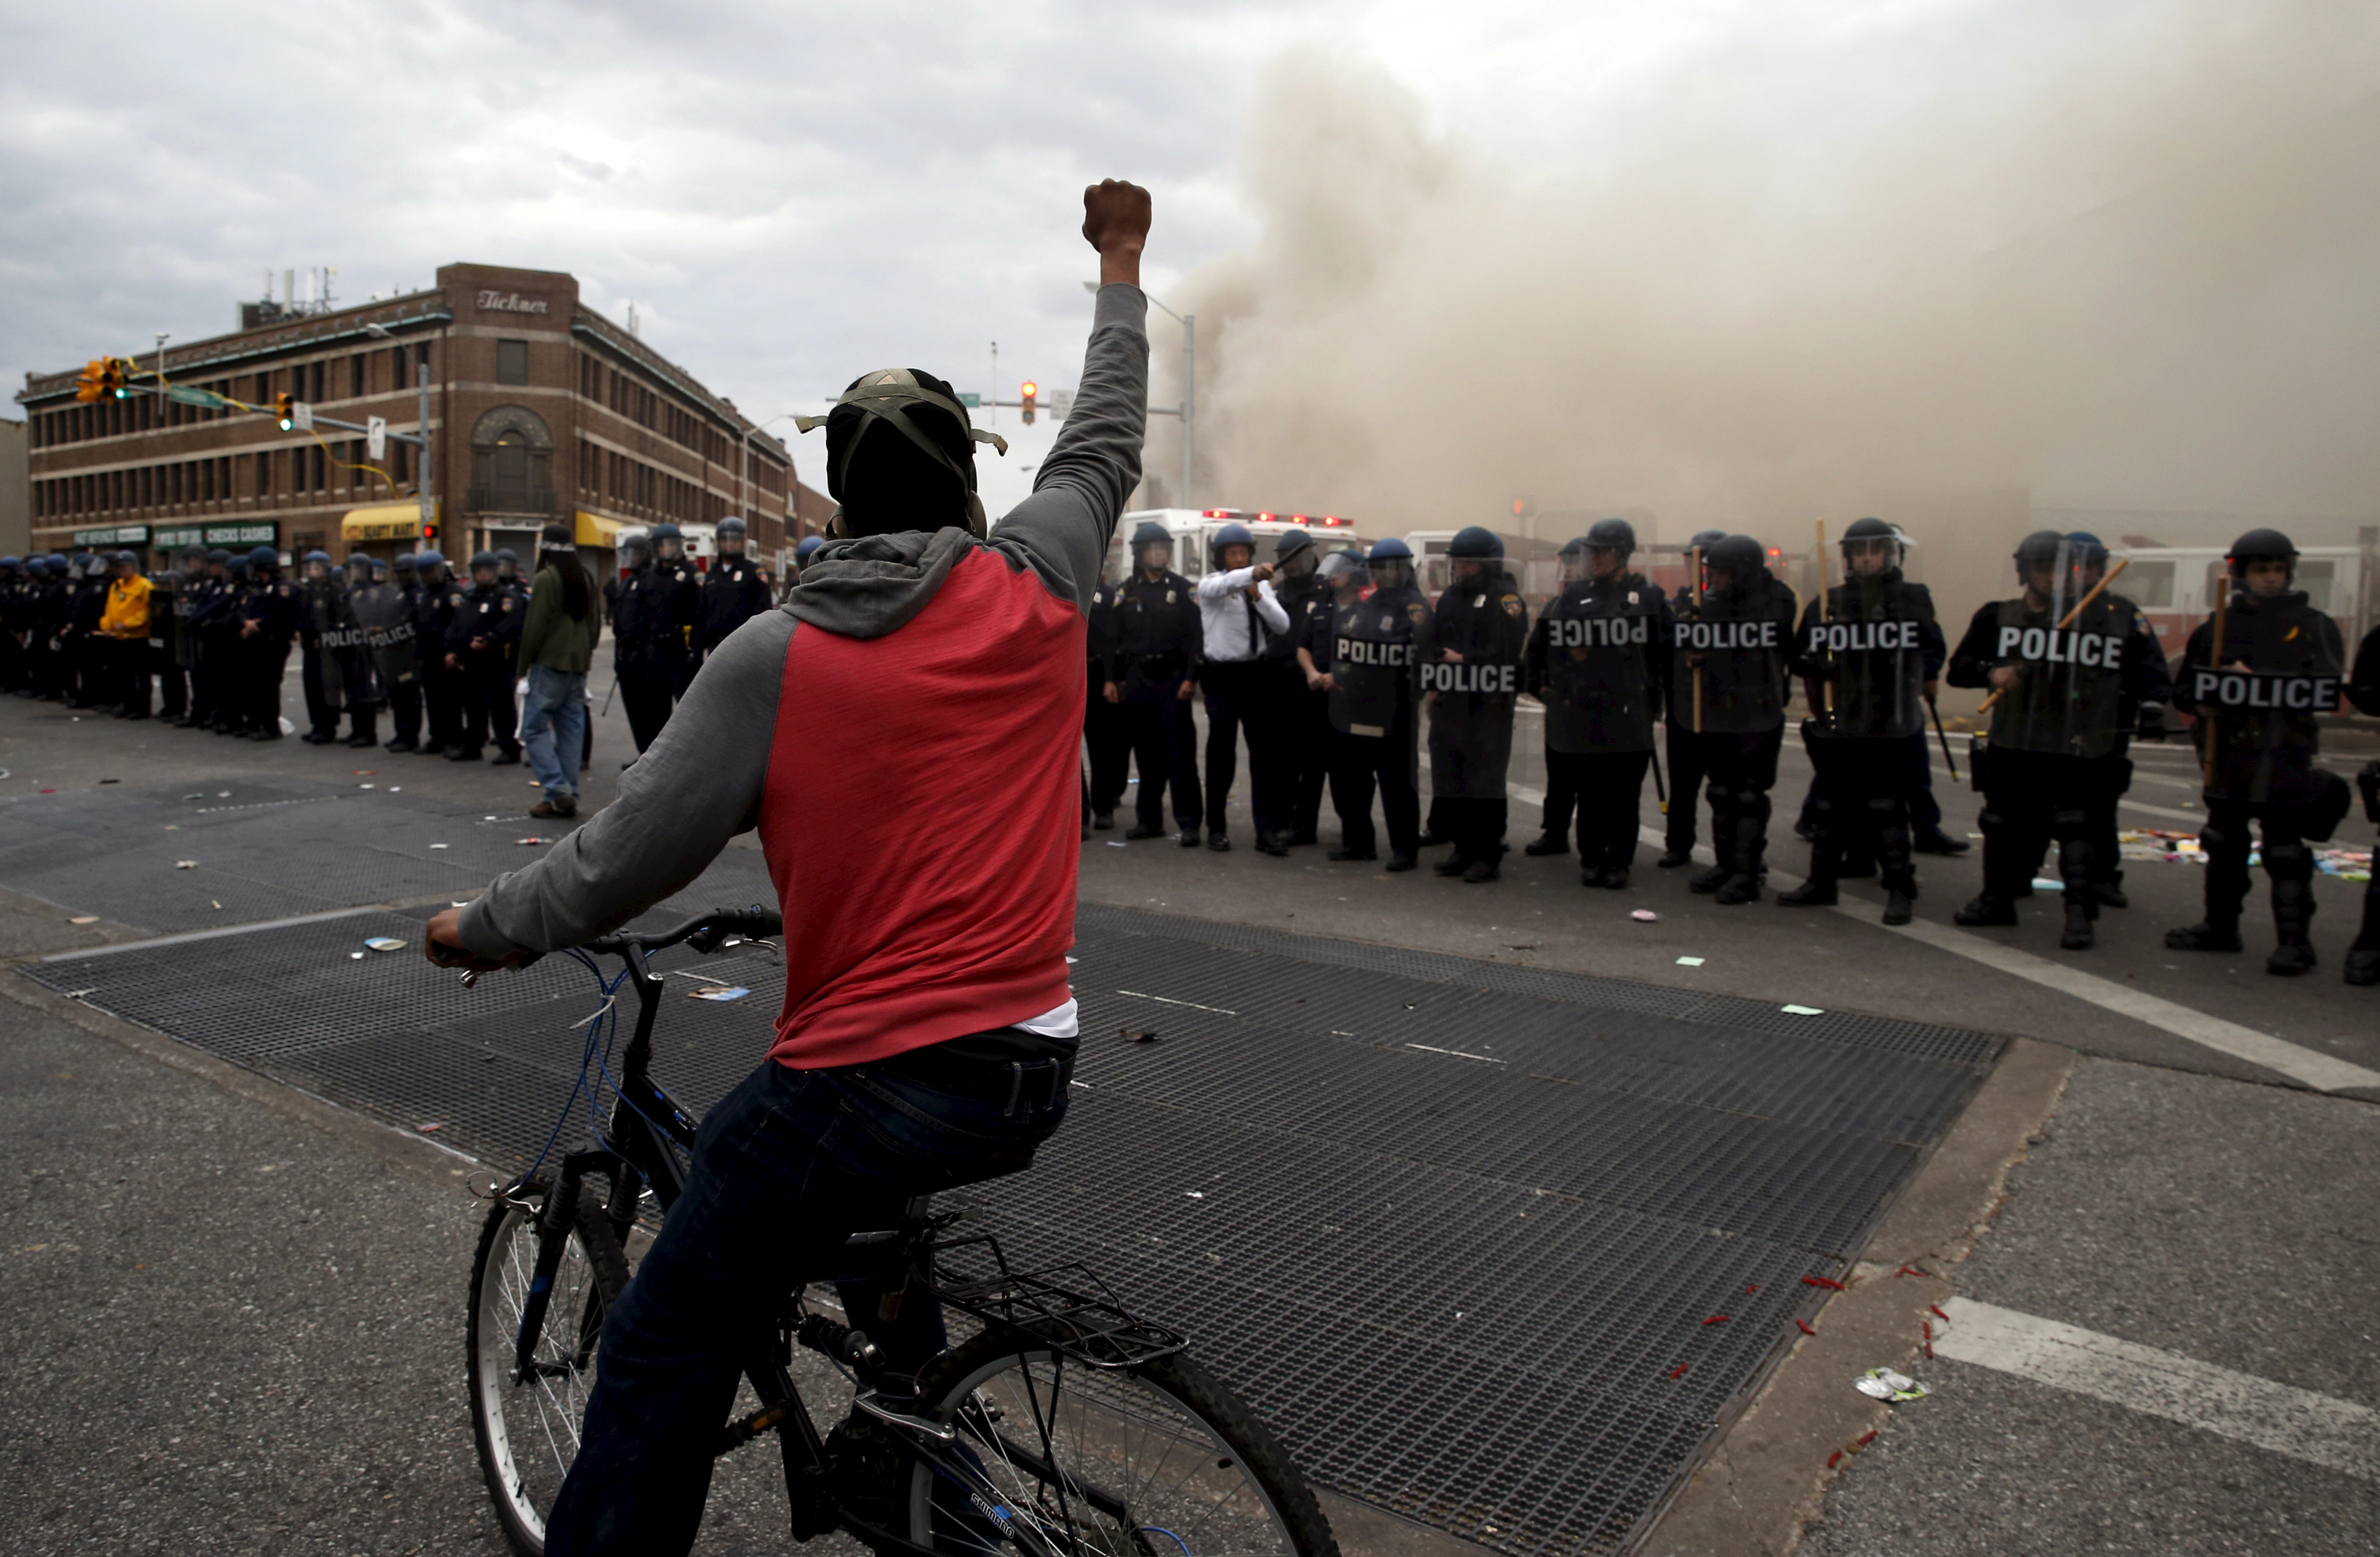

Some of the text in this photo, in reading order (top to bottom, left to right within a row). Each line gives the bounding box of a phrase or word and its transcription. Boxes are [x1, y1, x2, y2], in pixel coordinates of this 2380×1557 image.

[477, 289, 548, 314] Tickner
[369, 621, 417, 648] POLICE
[1549, 616, 1649, 647] POLICE
[1674, 621, 1778, 649] POLICE
[1810, 620, 1920, 653] POLICE
[1997, 626, 2123, 669] POLICE
[1420, 662, 1516, 692] POLICE
[2193, 671, 2338, 709] POLICE
[970, 1493, 1014, 1539] SHIMANO
